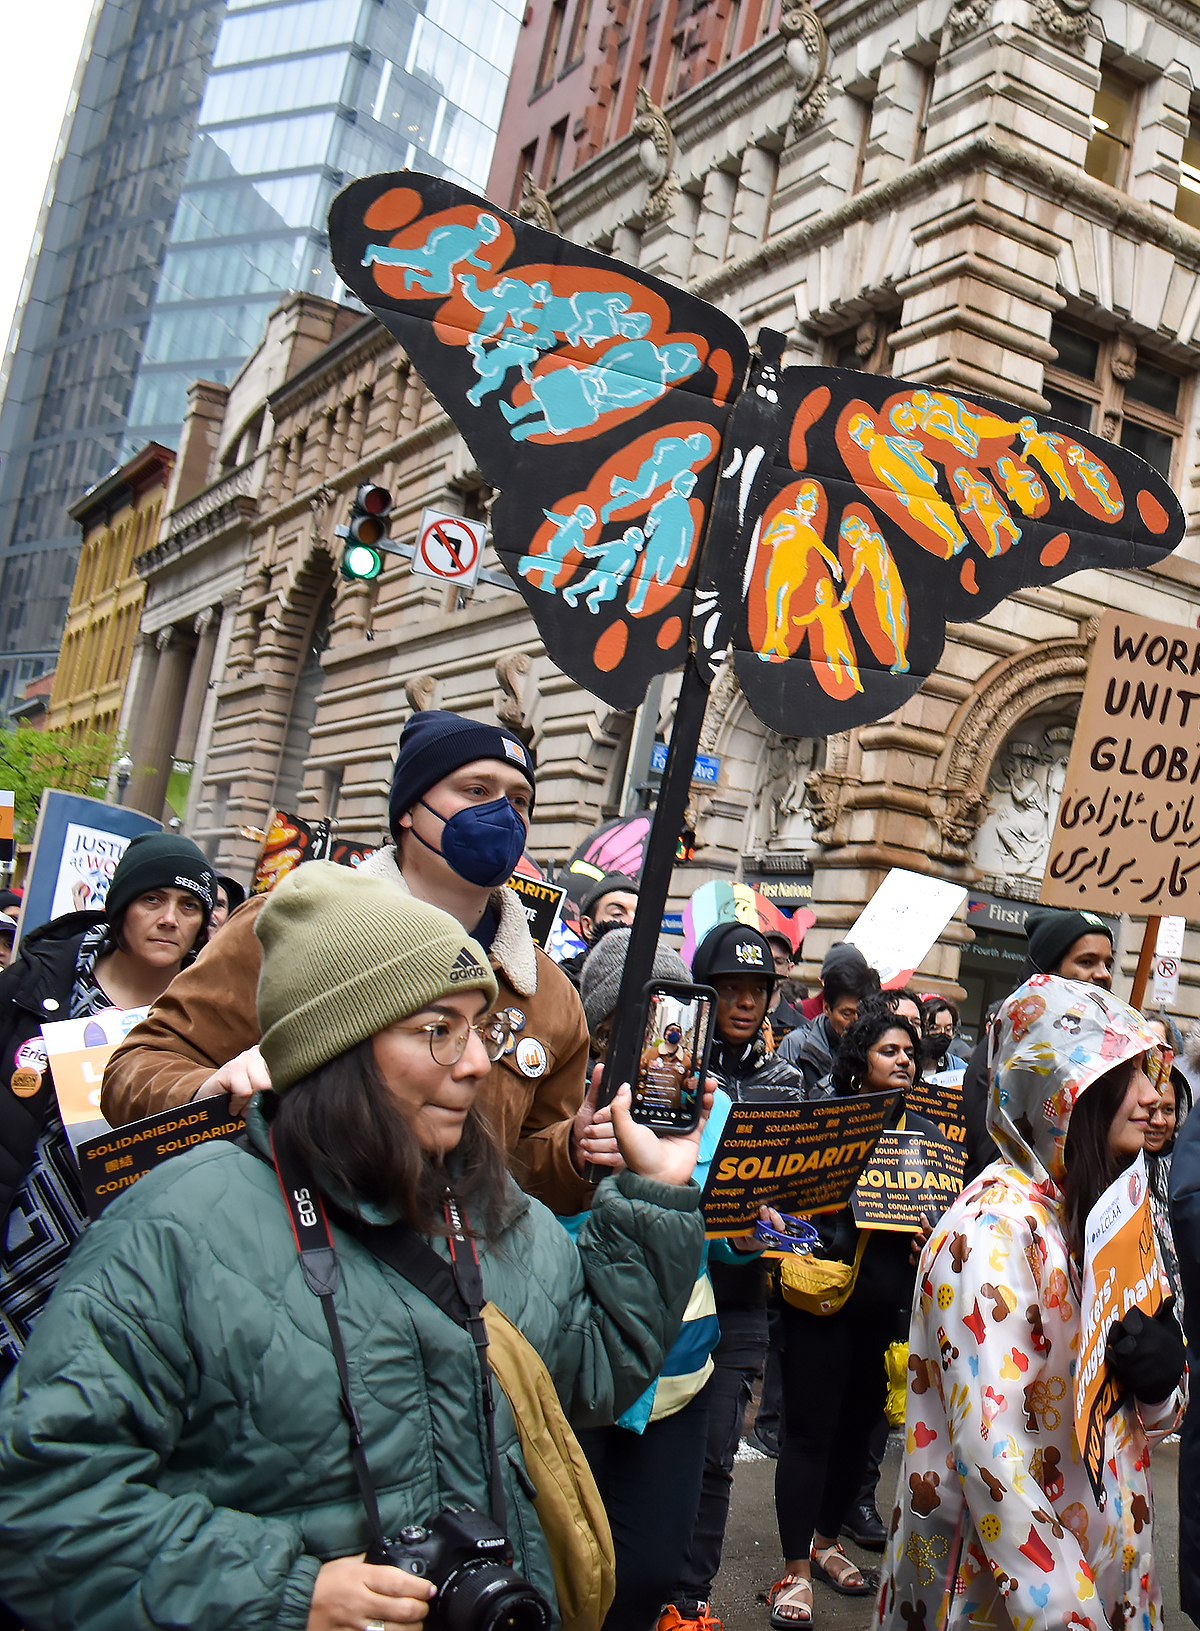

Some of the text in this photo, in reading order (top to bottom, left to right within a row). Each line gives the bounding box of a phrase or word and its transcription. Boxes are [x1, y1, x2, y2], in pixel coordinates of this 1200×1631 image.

[693, 760, 715, 780] Ave
[779, 881, 812, 899] Nationa
[988, 903, 1021, 924] First
[972, 943, 1000, 957] Fourth
[450, 966, 488, 982] adidas
[732, 1109, 801, 1119] SOLIDARIEDADE
[86, 1110, 209, 1160] SOLIDARIEDADE
[156, 1120, 247, 1155] SOLIDARIDA
[715, 1138, 876, 1181] SOLIDARITY
[294, 1188, 318, 1228] EOS
[477, 1539, 506, 1549] Canon
